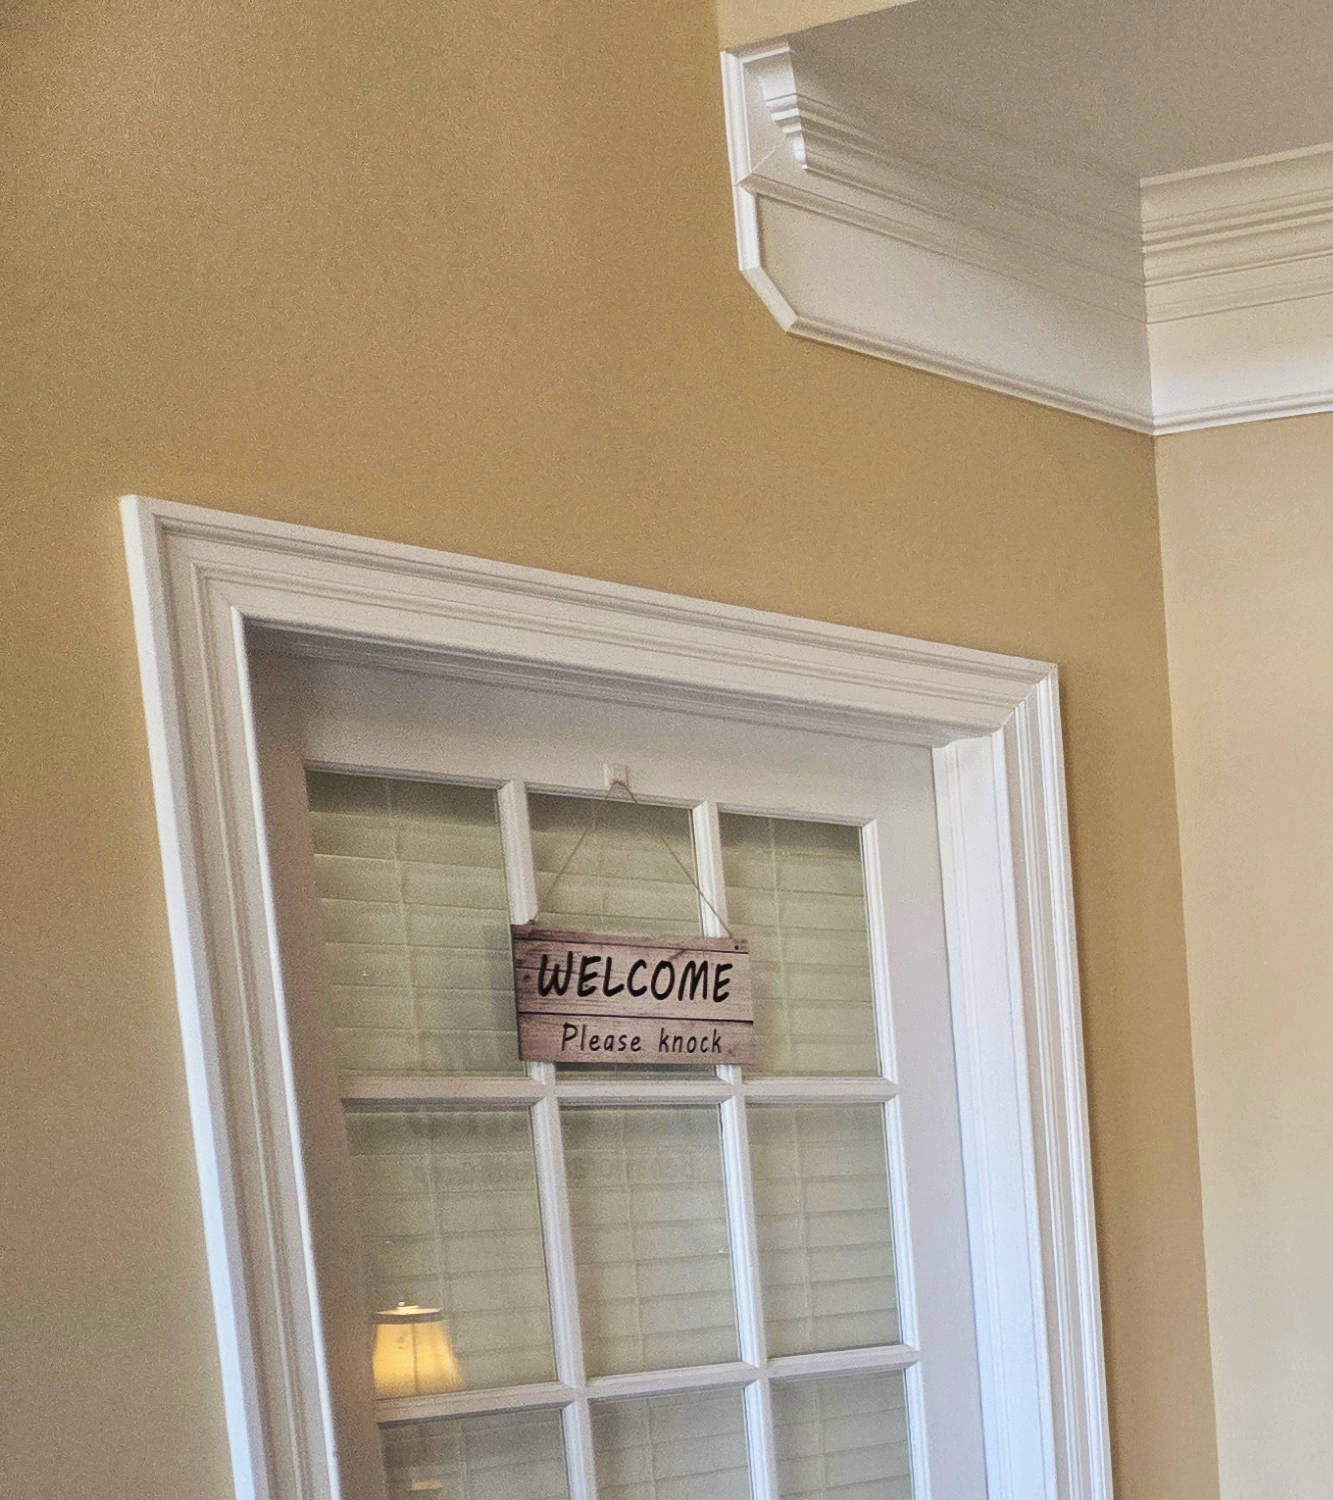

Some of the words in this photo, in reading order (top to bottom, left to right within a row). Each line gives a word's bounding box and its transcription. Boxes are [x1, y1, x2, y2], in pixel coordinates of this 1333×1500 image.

[537, 951, 733, 1003] WELCOME
[561, 1022, 641, 1053] Please
[659, 1027, 722, 1054] knock
